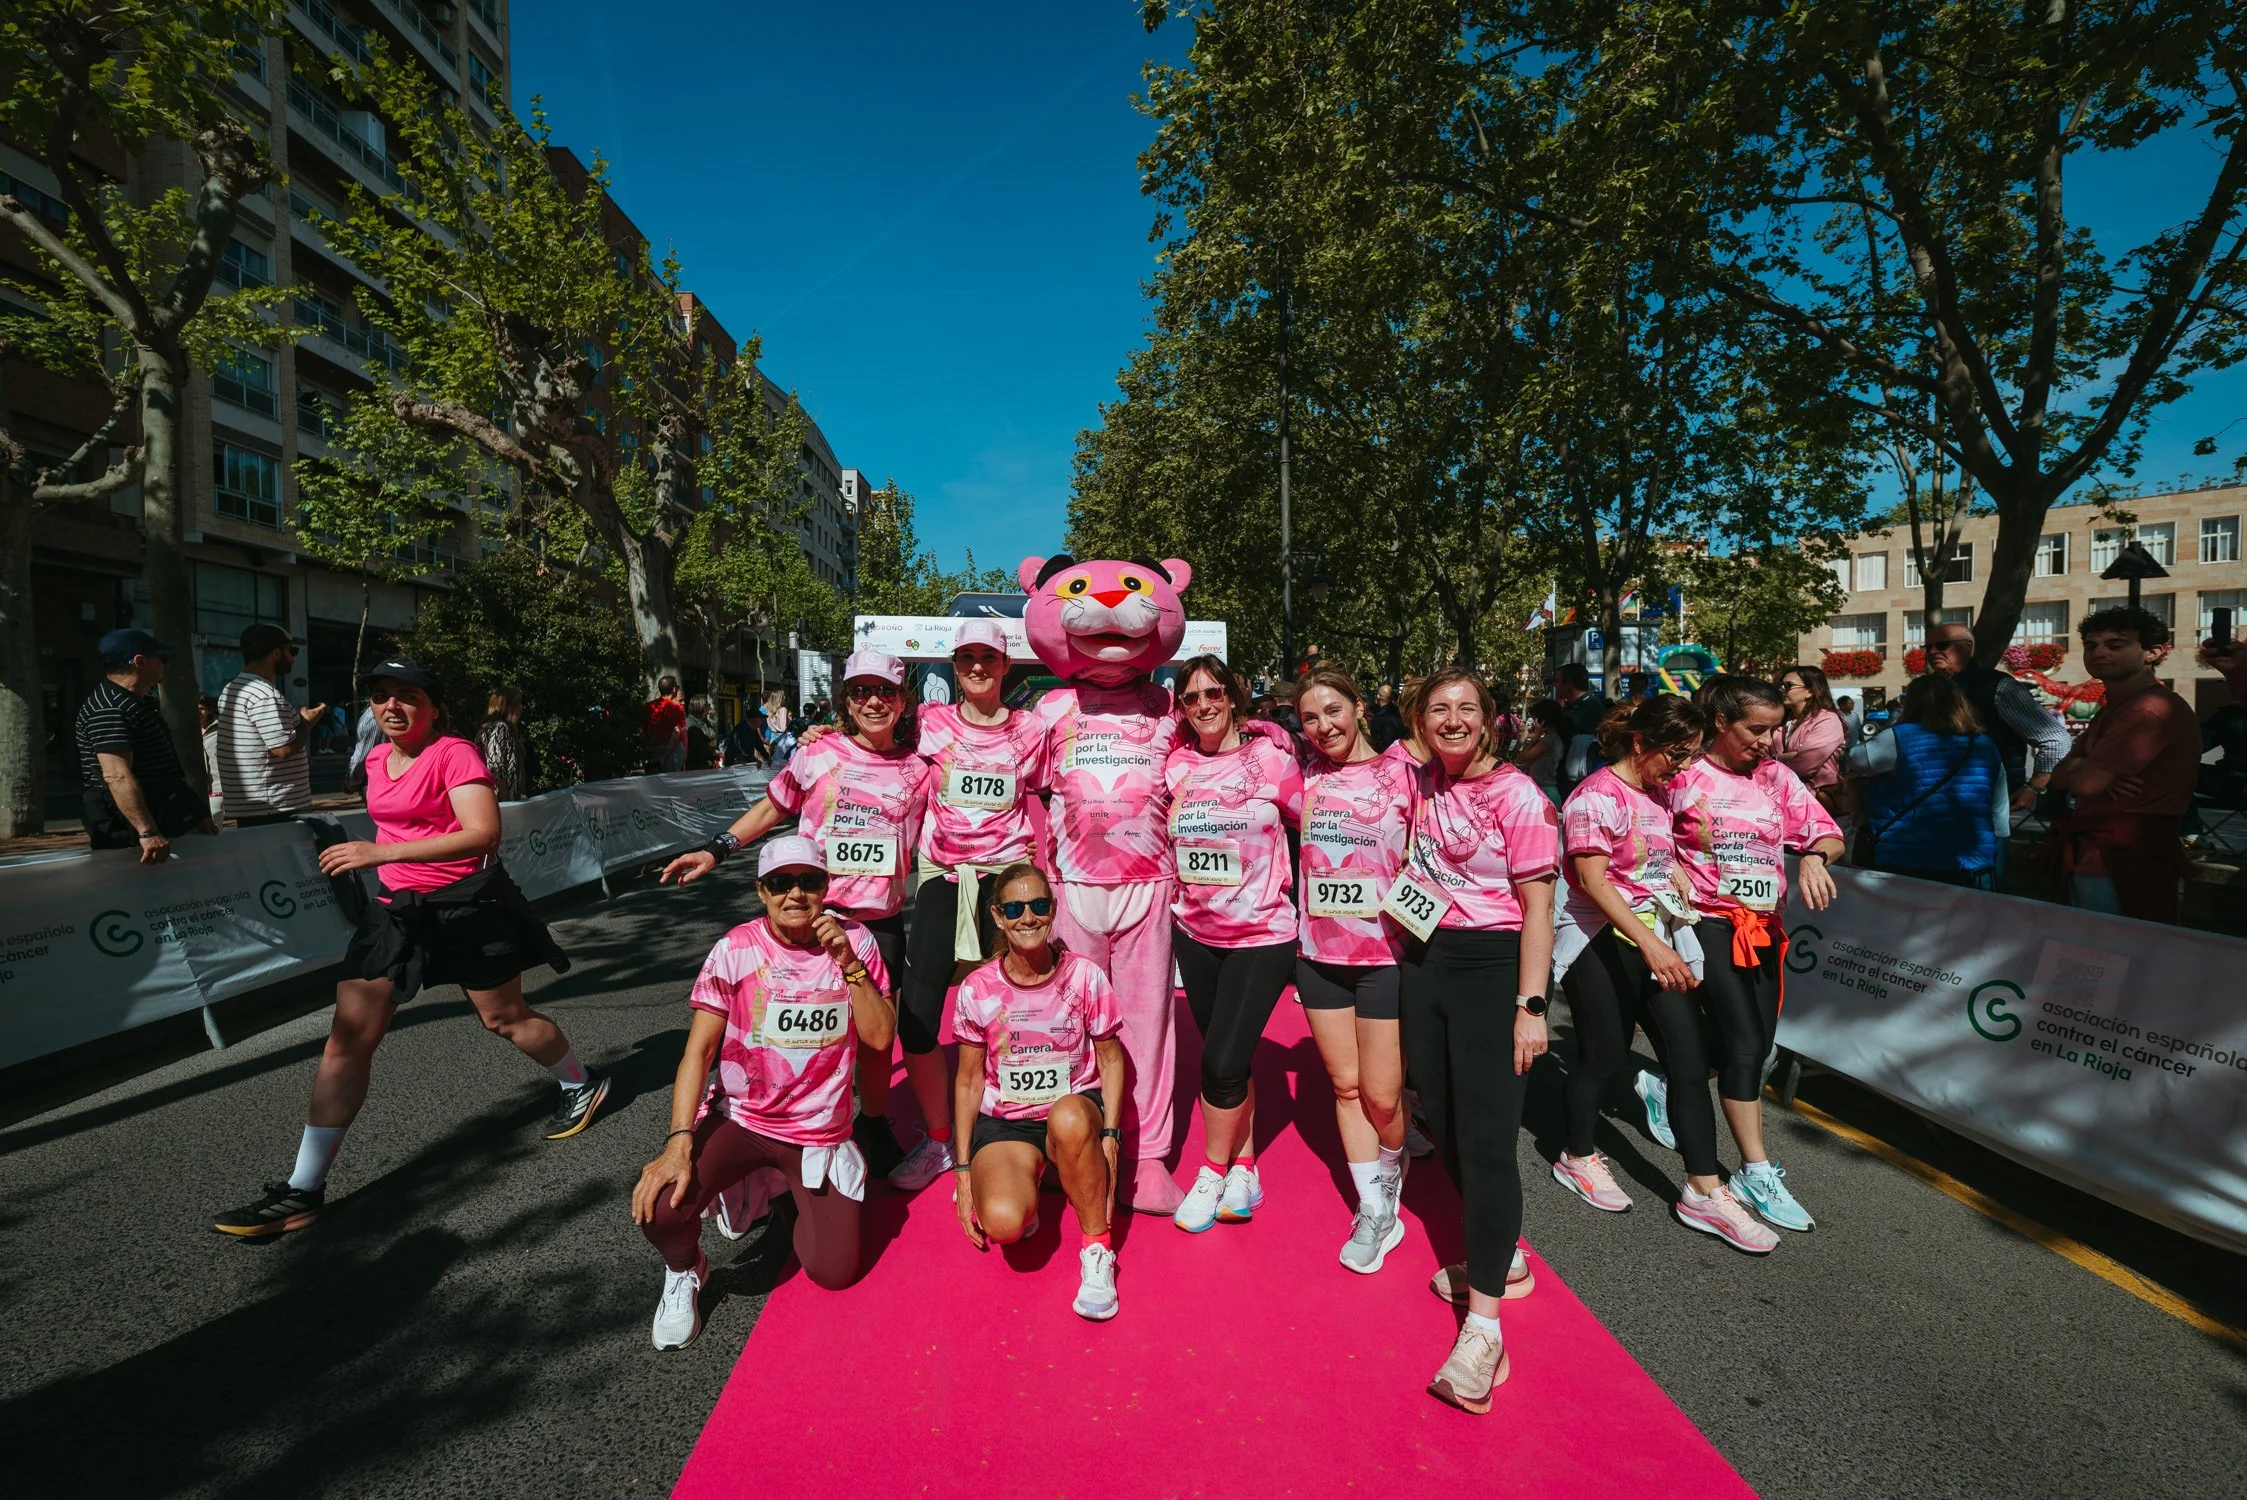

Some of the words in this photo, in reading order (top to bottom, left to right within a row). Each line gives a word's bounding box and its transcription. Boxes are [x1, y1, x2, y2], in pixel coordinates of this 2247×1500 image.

[934, 624, 952, 633] Rioja
[1592, 632, 1599, 642] P
[1076, 721, 1088, 730] XI
[1076, 732, 1120, 741] Carrera
[1075, 744, 1094, 756] por
[1096, 743, 1108, 753] la
[1075, 755, 1151, 766] Investigación
[839, 786, 850, 797] XI
[961, 775, 1005, 797] 8178
[1184, 789, 1194, 798] XI
[1315, 795, 1326, 805] XI
[836, 798, 880, 816] Carrera
[1181, 799, 1218, 809] Carrera
[834, 813, 853, 824] por
[854, 815, 866, 827] la
[1178, 812, 1195, 824] por
[1196, 810, 1206, 820] la
[1312, 807, 1351, 819] Carrera
[1178, 820, 1248, 834] Investigación
[1310, 820, 1326, 832] por
[1328, 820, 1338, 831] la
[1711, 817, 1723, 826] XI
[1310, 832, 1377, 848] Investigación
[1712, 829, 1757, 839] Carrera
[836, 842, 885, 863] 8675
[1648, 847, 1670, 857] Carrera
[1713, 843, 1733, 853] por
[1733, 841, 1744, 850] la
[1188, 852, 1229, 871] 8211
[300, 887, 327, 899] contra
[1318, 883, 1363, 904] 9732
[1730, 878, 1771, 898] 2501
[144, 901, 202, 918] asociación
[204, 890, 250, 906] española
[304, 902, 315, 910] en
[1396, 884, 1435, 921] 9733
[150, 916, 188, 931] contra
[189, 912, 199, 923] el
[200, 906, 235, 921] cáncer
[7, 924, 76, 945] española
[154, 934, 172, 944] en
[173, 930, 187, 940] La
[188, 924, 214, 937] Rioja
[1832, 941, 1898, 967] asociación
[1899, 960, 1962, 986] española
[1827, 955, 1866, 974] contra
[1868, 967, 1880, 979] el
[1882, 972, 1928, 993] cáncer
[1822, 969, 1838, 981] en
[1840, 973, 1855, 987] La
[1856, 979, 1888, 1000] Rioja
[751, 986, 767, 1044] mujer
[778, 1008, 838, 1032] 6486
[1009, 1031, 1020, 1041] XI
[2042, 1001, 2141, 1039] asociación
[2146, 1030, 2247, 1070] española
[1010, 1044, 1052, 1054] Carrera
[2036, 1020, 2095, 1047] contra
[2100, 1038, 2118, 1054] el
[2122, 1046, 2196, 1078] cáncer
[2030, 1038, 2052, 1055] en
[2056, 1044, 2079, 1063] La
[2083, 1052, 2132, 1081] Rioja
[1009, 1069, 1058, 1091] 5923
